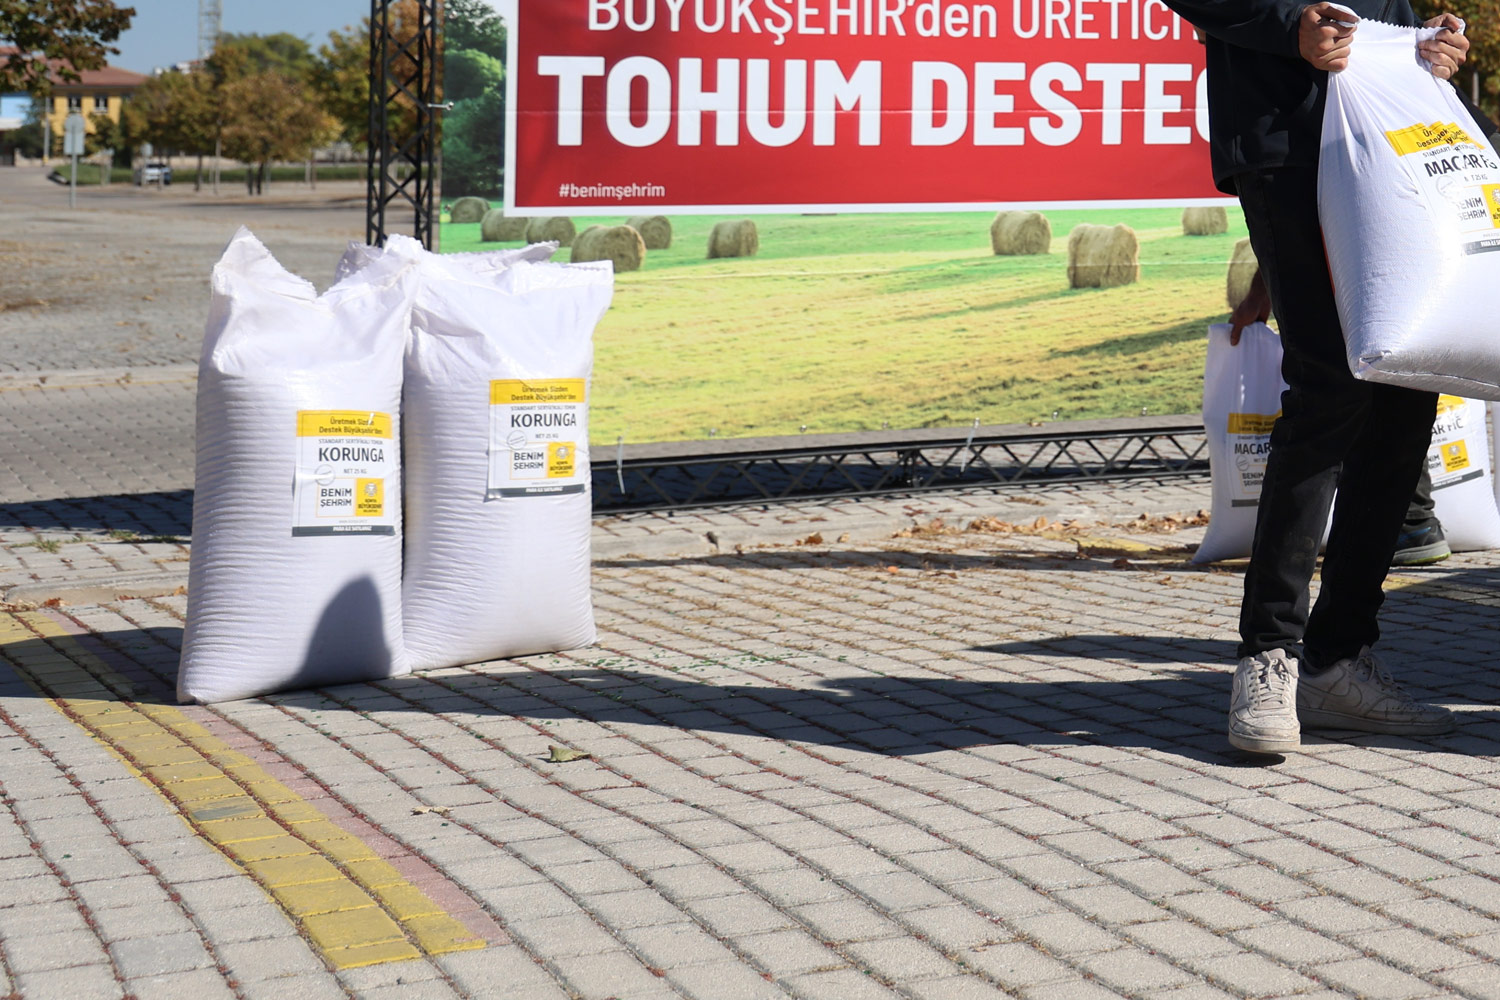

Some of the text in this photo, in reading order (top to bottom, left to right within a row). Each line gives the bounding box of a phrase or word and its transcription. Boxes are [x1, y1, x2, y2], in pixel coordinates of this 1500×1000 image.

[538, 55, 1210, 147] TOHUM DESTE
[1424, 154, 1482, 177] MACAR
[511, 413, 577, 428] KORUNGA
[319, 447, 384, 463] KORUNGA
[1234, 443, 1272, 455] MACAR
